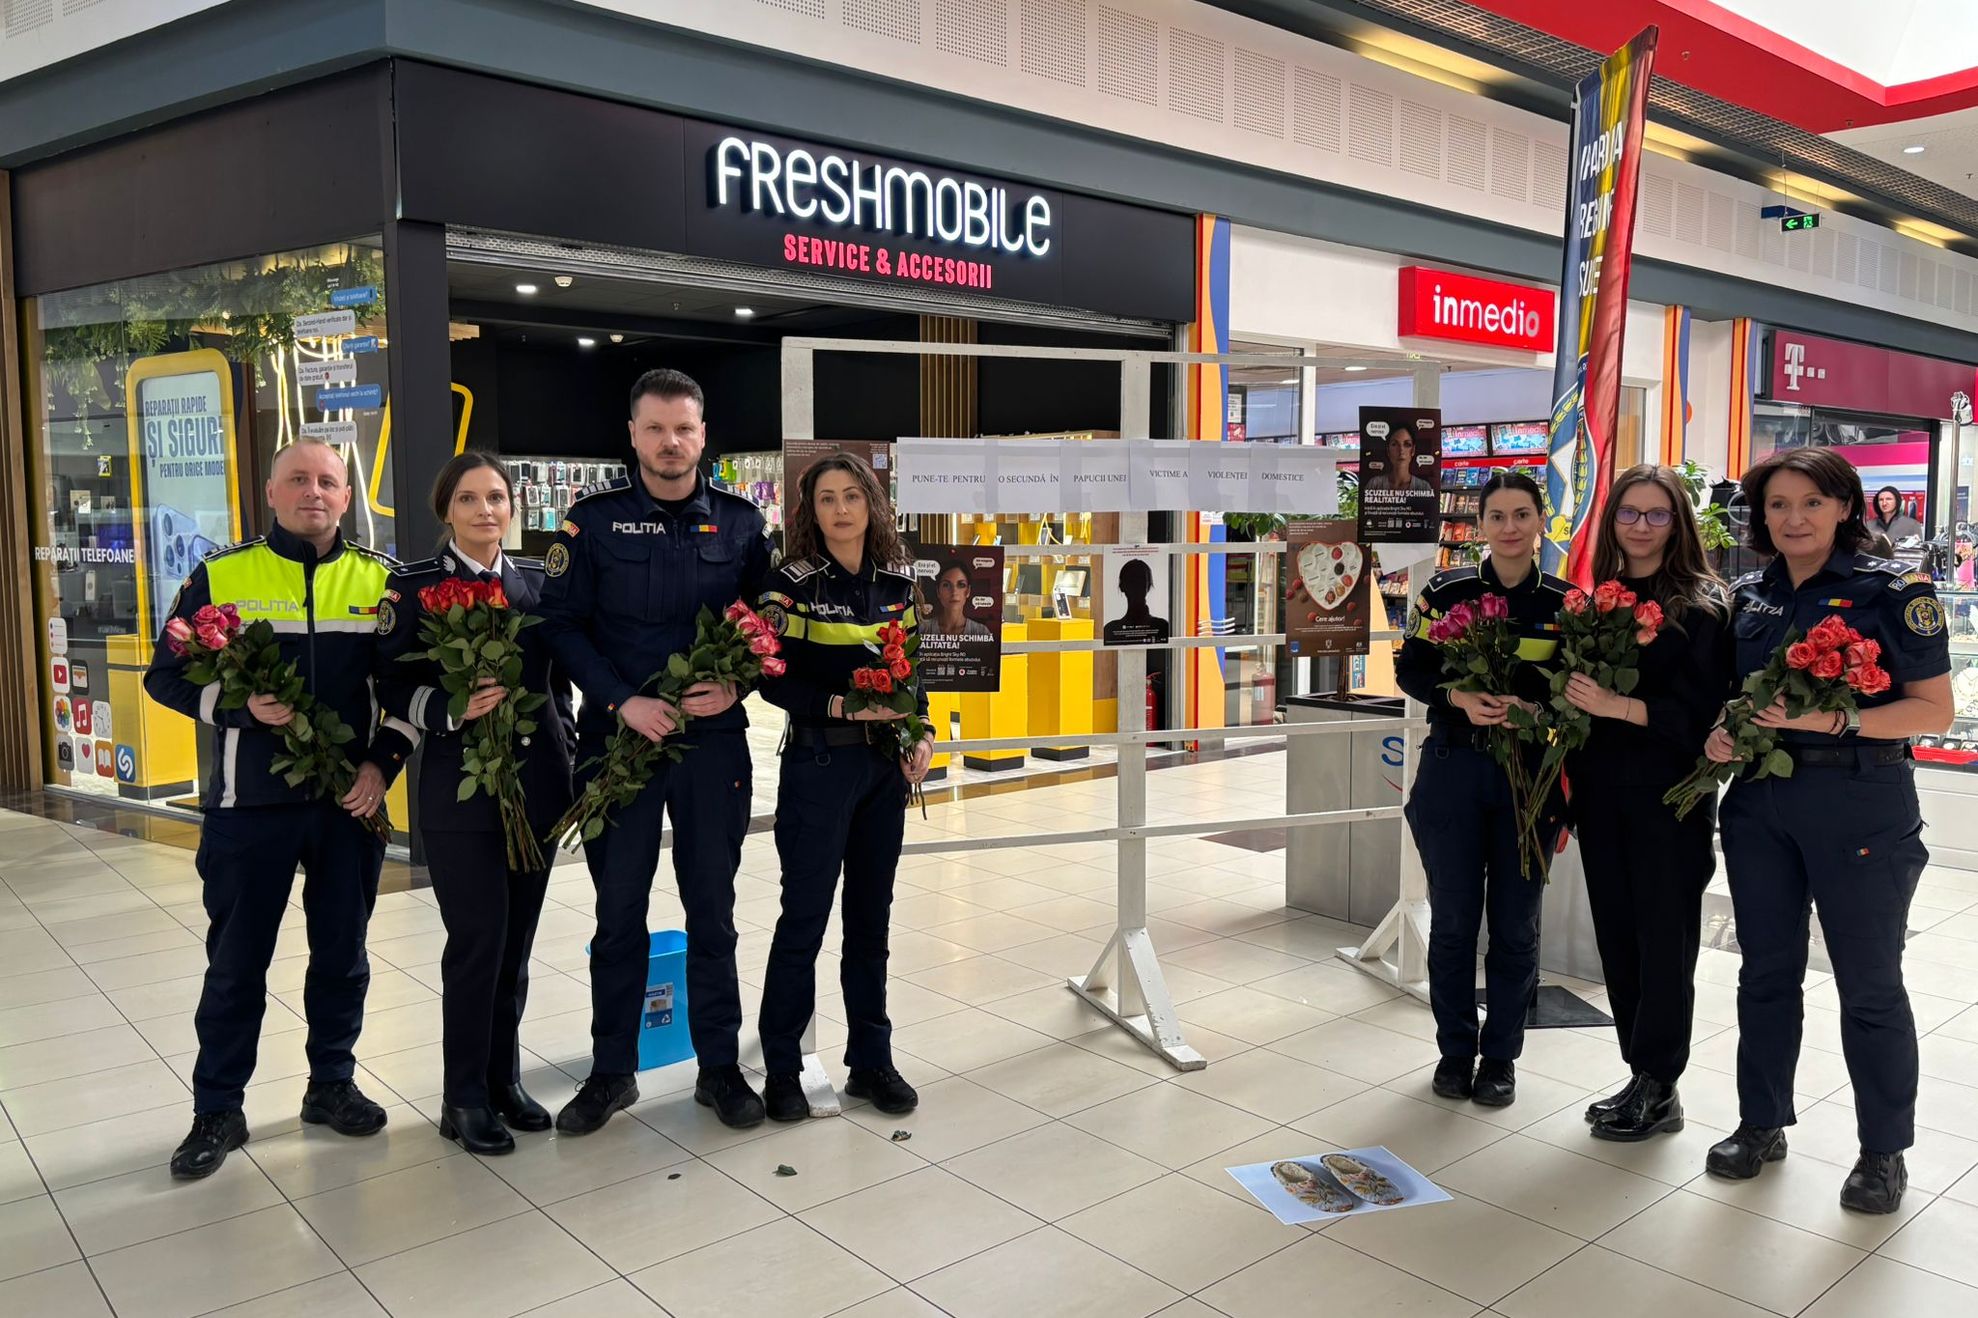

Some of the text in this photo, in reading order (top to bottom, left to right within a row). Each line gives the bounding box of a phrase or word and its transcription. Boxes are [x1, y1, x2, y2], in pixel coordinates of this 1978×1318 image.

[784, 232, 993, 289] SERVICE & ACCESORII
[1433, 284, 1540, 338] inmedio
[145, 395, 207, 418] REPARAȚII RAPIDE
[146, 420, 163, 468] ȘI
[160, 462, 183, 478] PENTRU
[185, 461, 203, 477] ORICE
[912, 474, 949, 483] PUNE-TE
[952, 475, 986, 483] PENTRU
[998, 475, 1005, 483] O
[1050, 472, 1059, 483] ÎN
[1073, 475, 1106, 484] PAPUCII
[1107, 475, 1127, 483] UNEI
[1149, 469, 1181, 478] VICTIME
[1207, 471, 1248, 481] VIOLENȚEI
[1261, 472, 1304, 482] DOMESTICE
[1364, 488, 1435, 498] SCUZELE NU SCHIMBĂ
[34, 546, 135, 567] REPARAȚII TELEFOANE
[946, 634, 958, 642] NU
[959, 632, 994, 642] SCHIMBĂ
